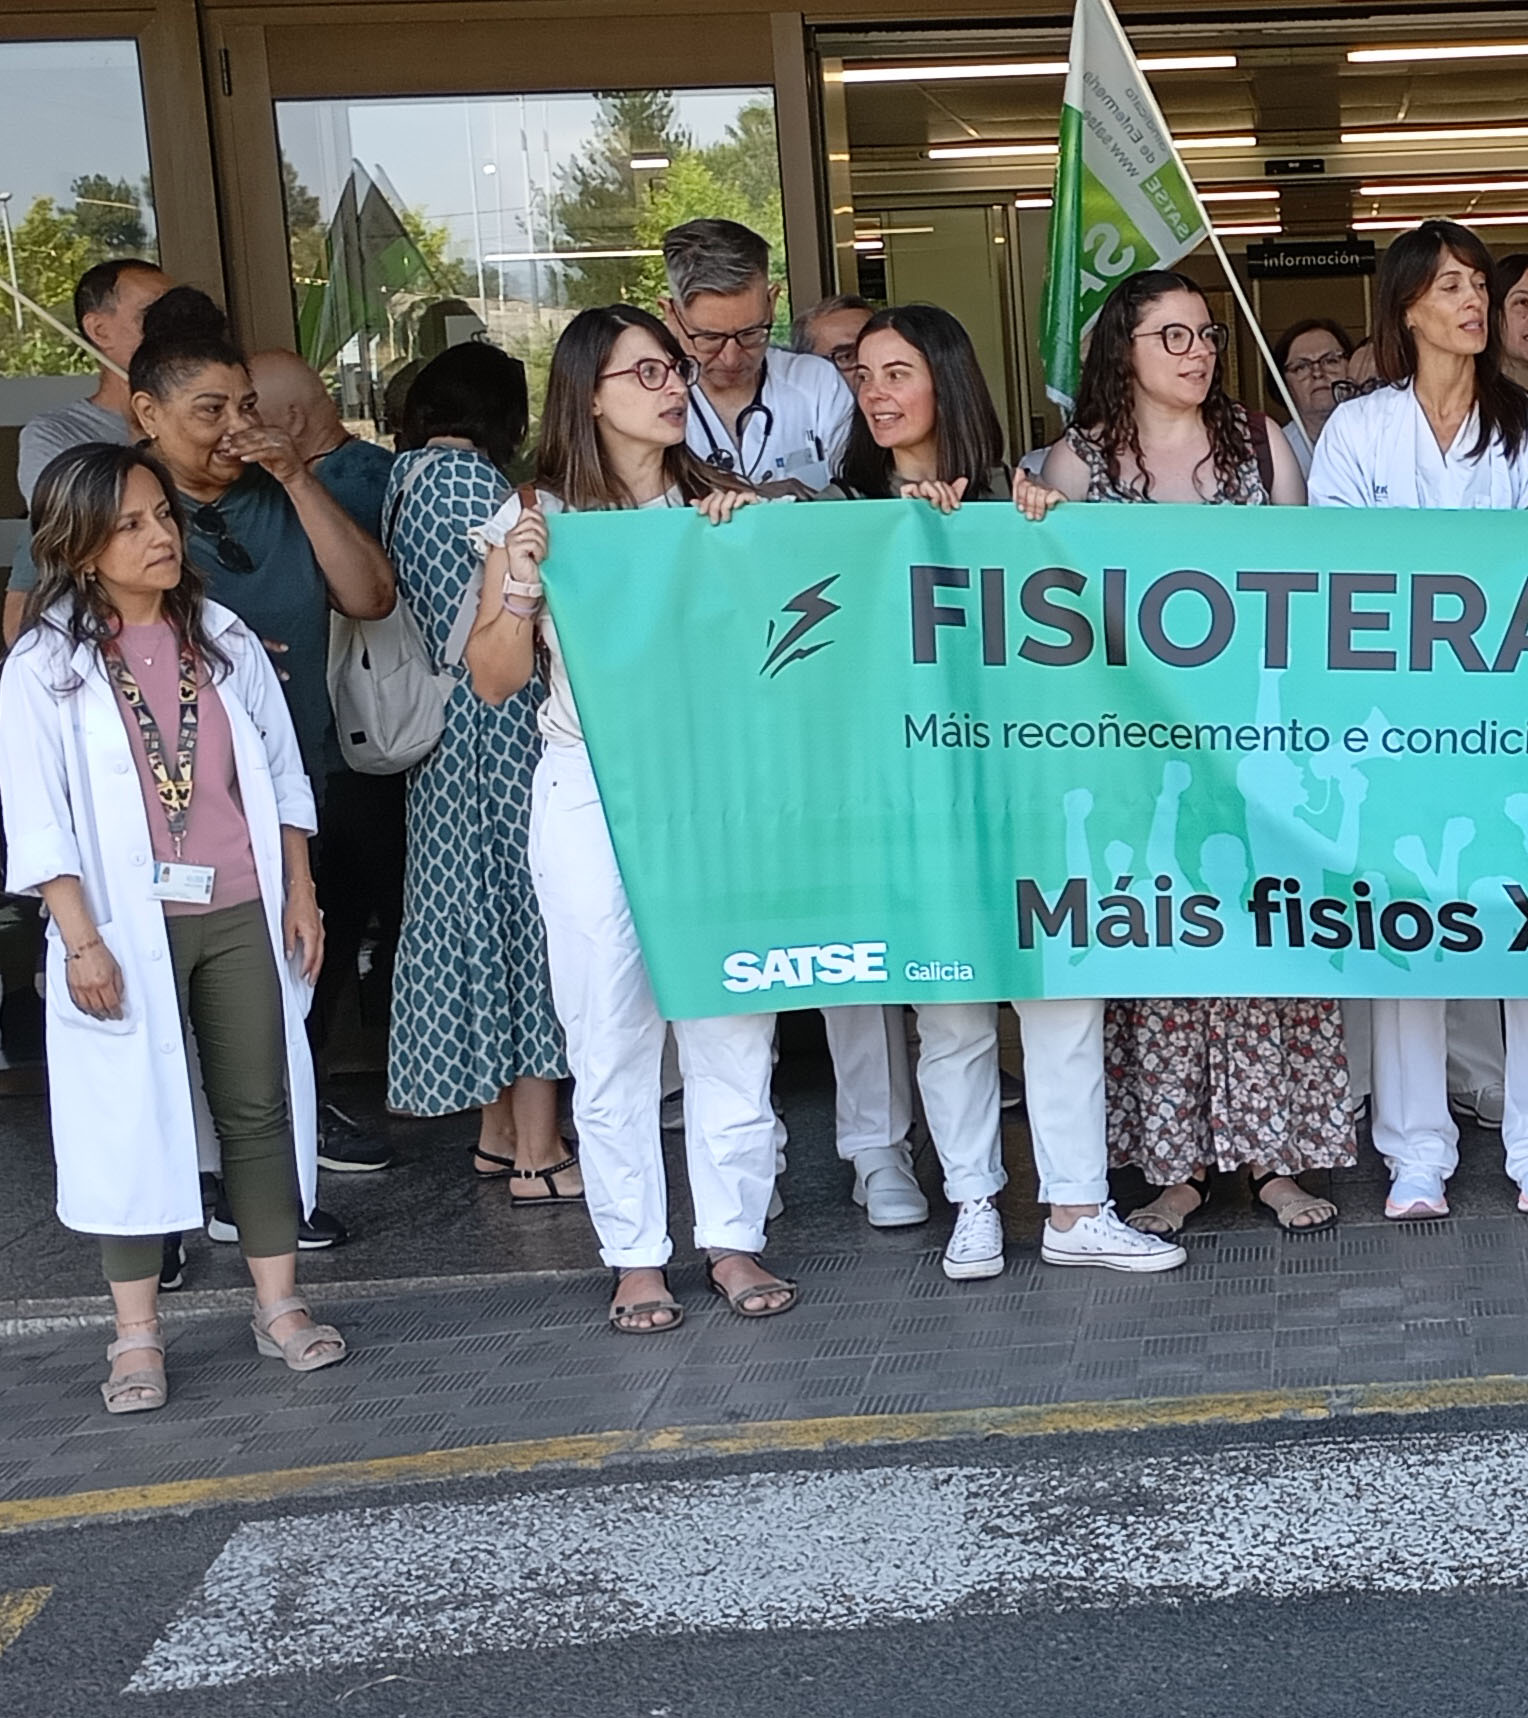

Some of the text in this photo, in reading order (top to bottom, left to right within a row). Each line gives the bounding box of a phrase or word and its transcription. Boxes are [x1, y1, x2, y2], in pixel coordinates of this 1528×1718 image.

[1263, 250, 1360, 268] información
[903, 712, 990, 749] Máis
[1002, 713, 1330, 752] recoñecemento
[1342, 727, 1369, 753] e
[1015, 874, 1225, 950] Máis
[1247, 876, 1484, 953] fisios
[722, 941, 974, 993] SATSE Galicia
